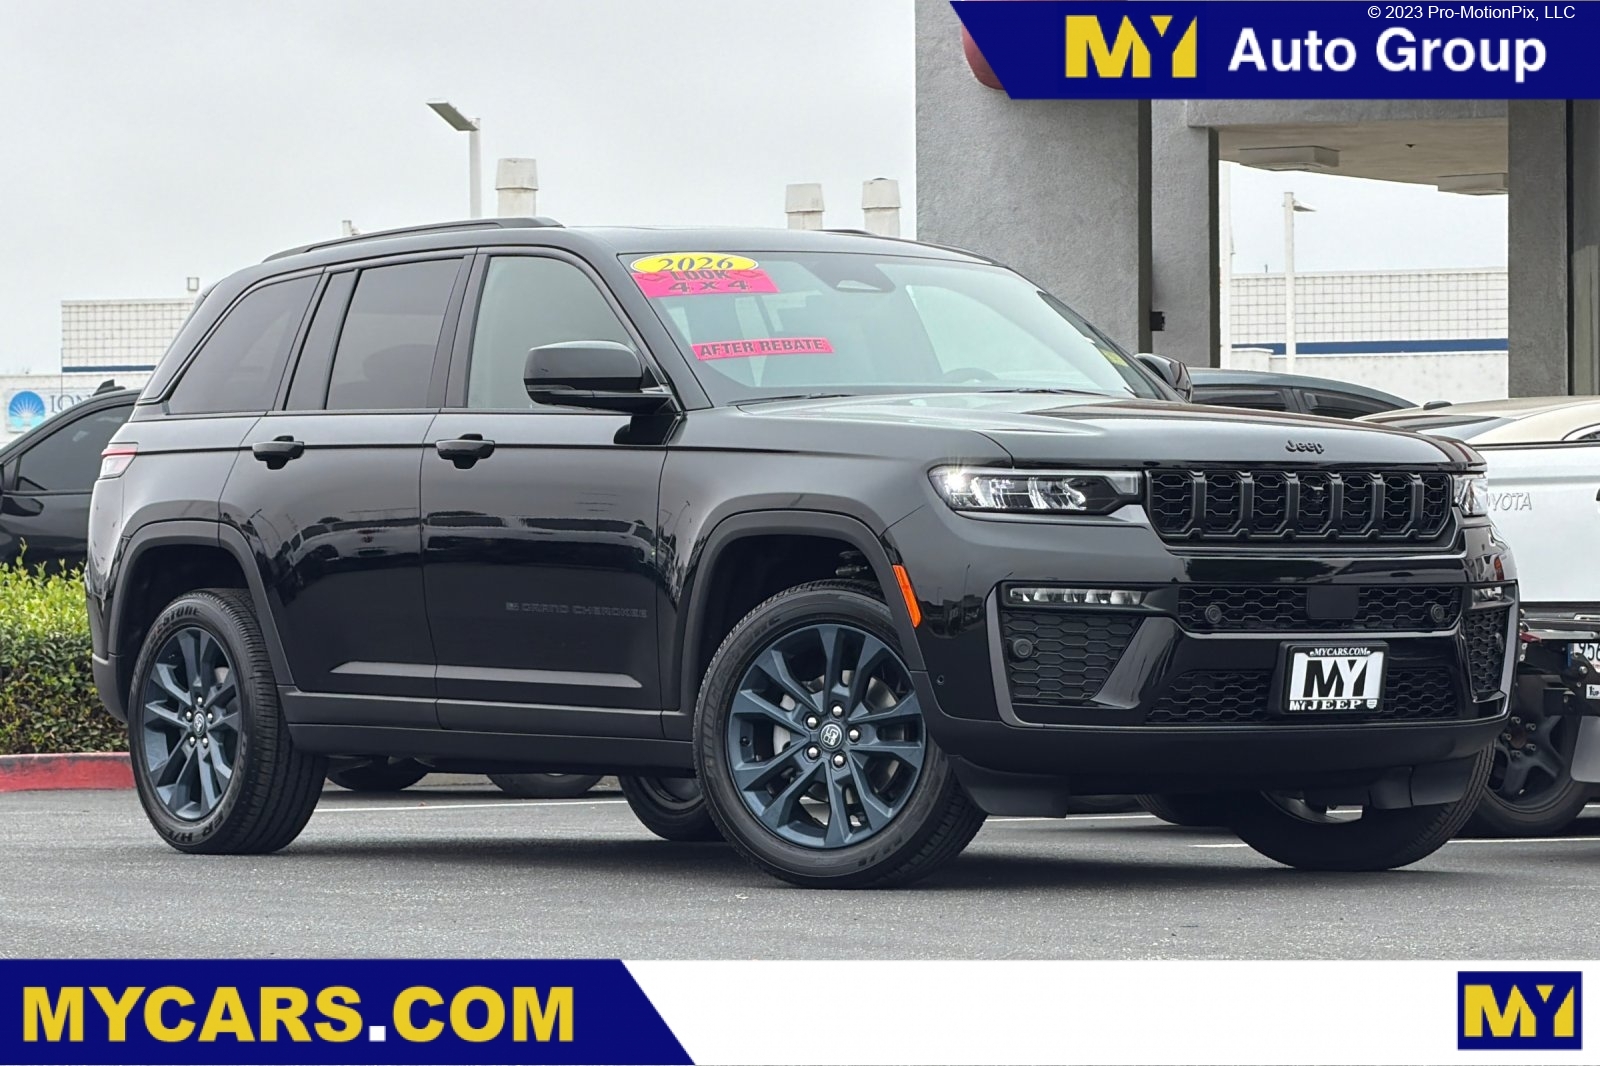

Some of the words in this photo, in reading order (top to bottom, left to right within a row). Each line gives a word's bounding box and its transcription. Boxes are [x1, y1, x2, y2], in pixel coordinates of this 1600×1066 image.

[658, 256, 734, 272] 2026
[670, 269, 731, 281] LOOK
[700, 341, 754, 356] AFTER
[759, 339, 824, 352] REBATE
[1285, 440, 1324, 454] Jeep
[1311, 648, 1369, 656] MYCARS.COM
[1303, 659, 1368, 698] MY
[1308, 700, 1362, 710] JEEP
